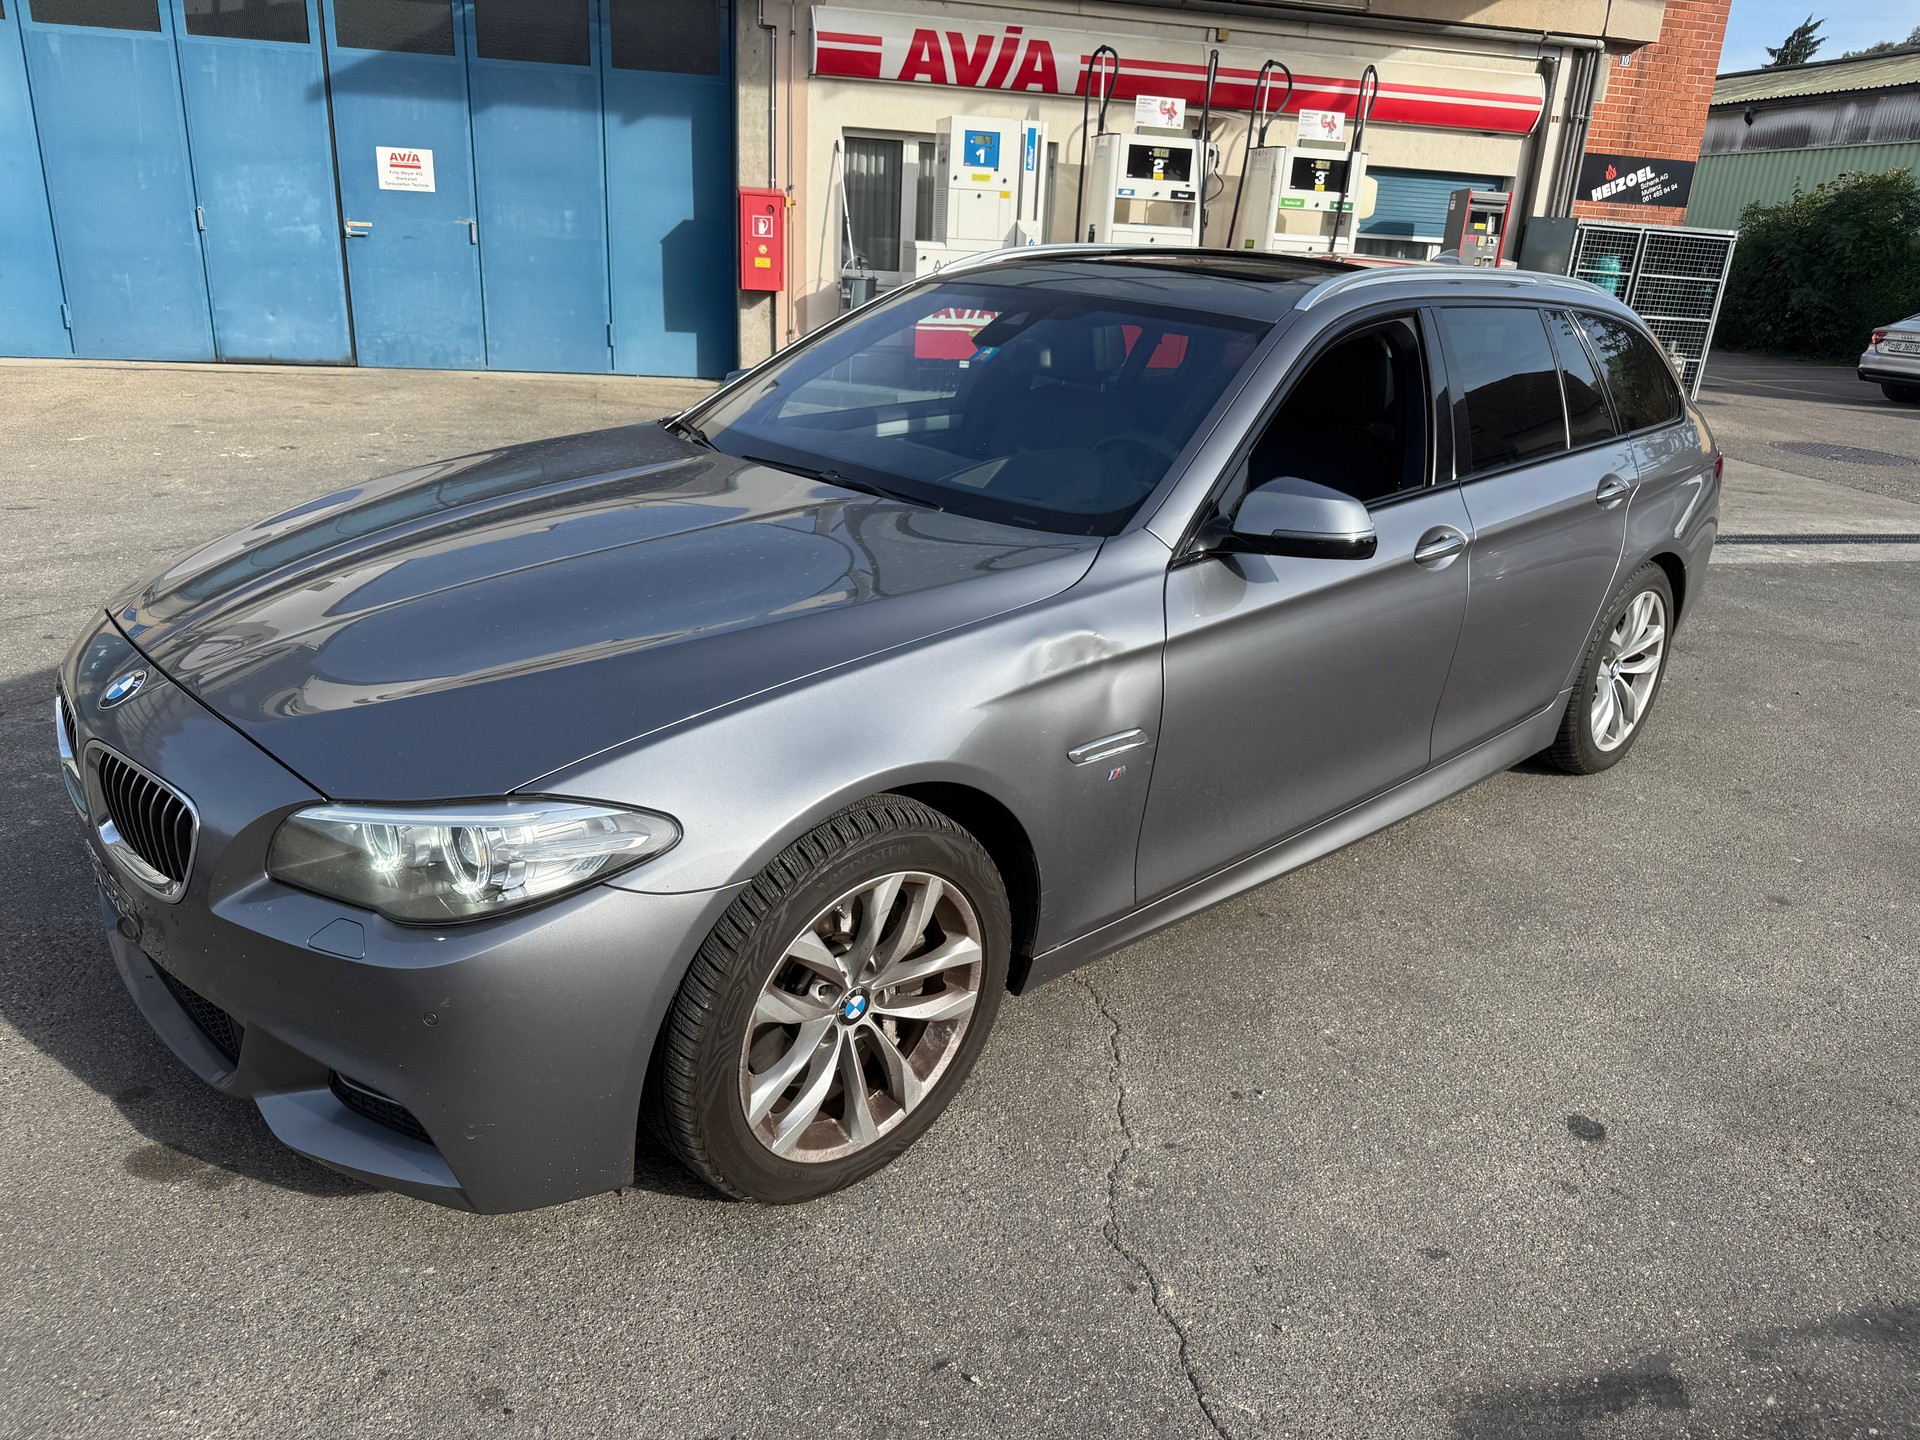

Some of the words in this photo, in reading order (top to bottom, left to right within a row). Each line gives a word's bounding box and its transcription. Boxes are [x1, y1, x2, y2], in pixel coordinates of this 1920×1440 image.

[897, 25, 1059, 94] AVIA
[1621, 55, 1630, 66] 10
[390, 151, 420, 162] AVIA
[975, 148, 985, 164] 1
[1153, 158, 1165, 173] 2
[1315, 170, 1326, 185] 3
[1591, 166, 1655, 201] HEIZOEL
[1660, 173, 1668, 181] AG
